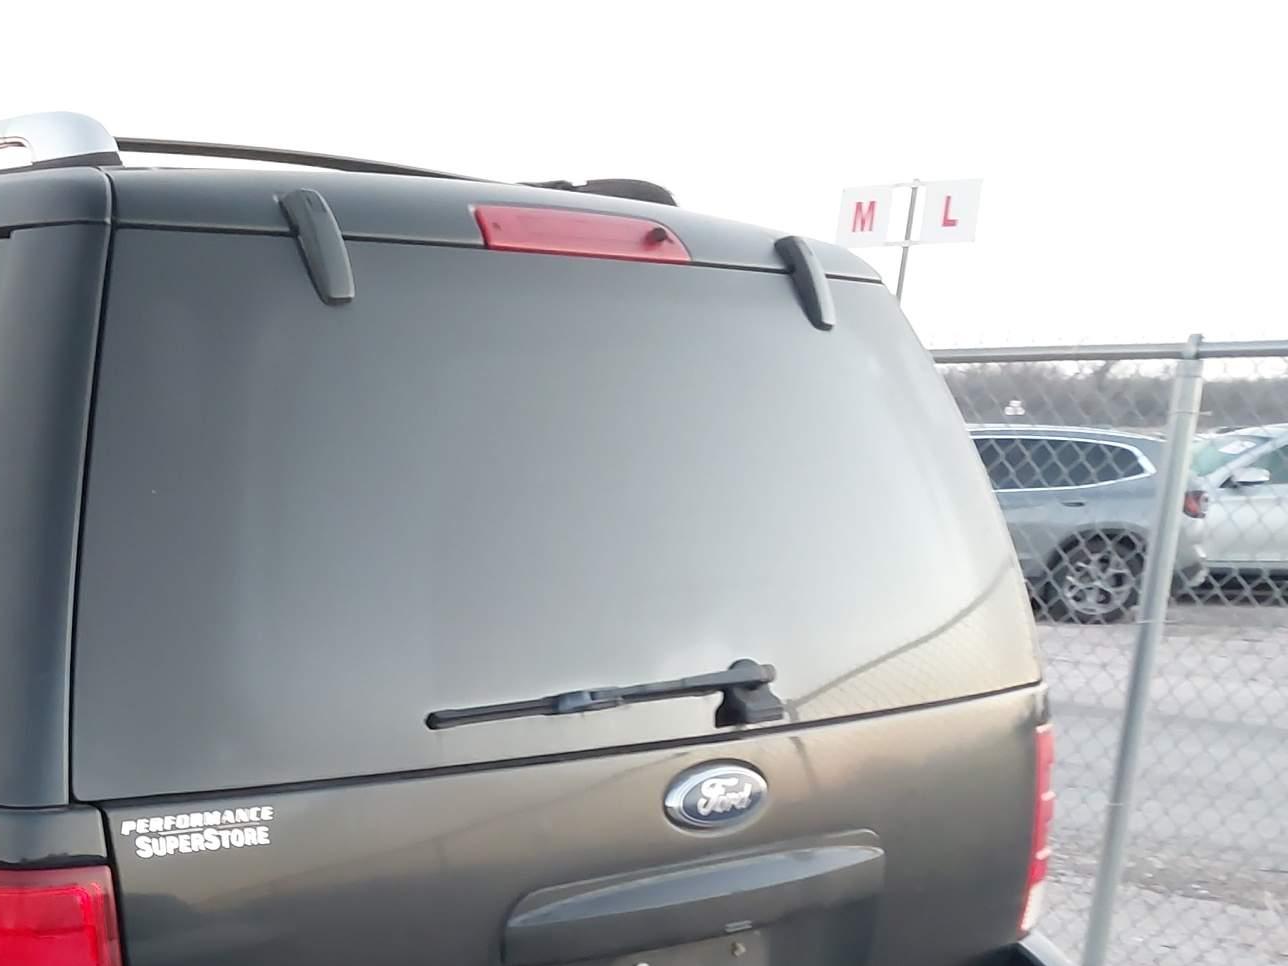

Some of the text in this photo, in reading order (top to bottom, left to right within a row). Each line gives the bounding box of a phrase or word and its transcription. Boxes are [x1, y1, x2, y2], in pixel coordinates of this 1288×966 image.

[852, 201, 876, 232] M
[941, 196, 958, 227] L
[697, 777, 753, 816] Ford
[120, 806, 274, 836] PERFORMANCE
